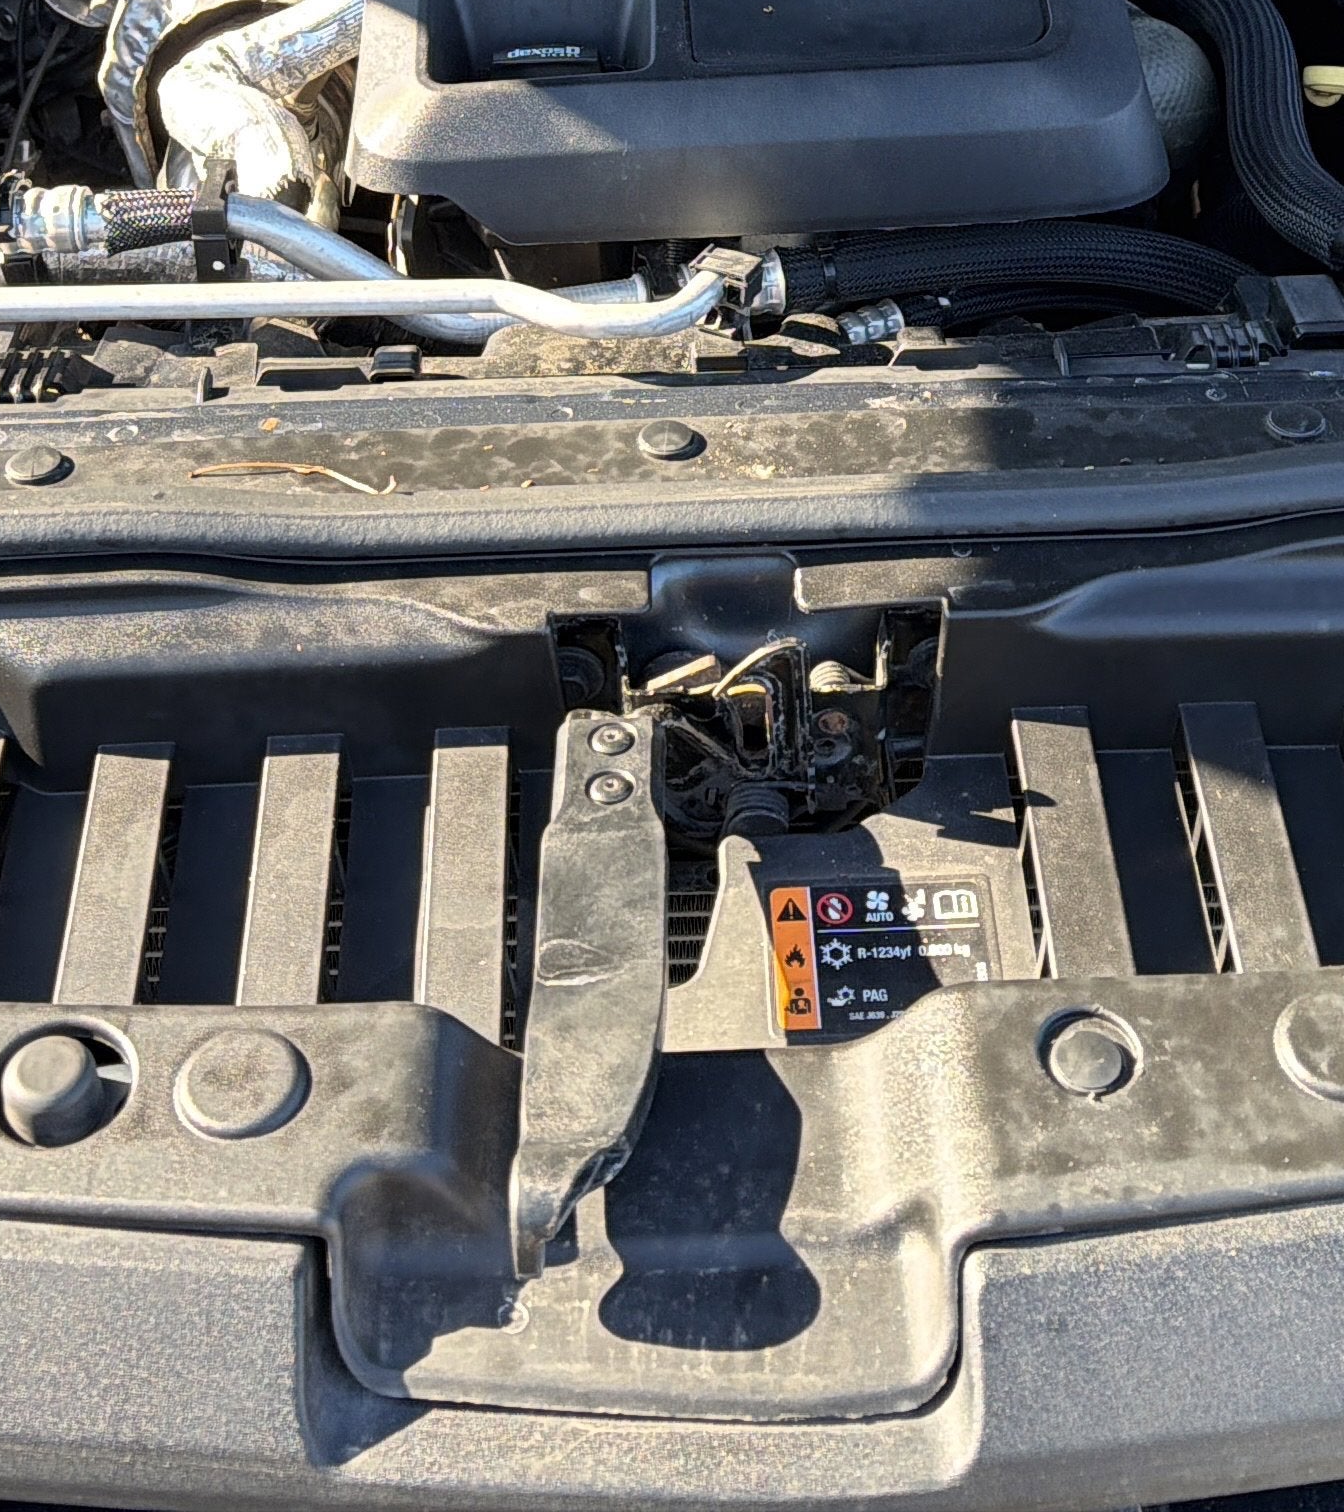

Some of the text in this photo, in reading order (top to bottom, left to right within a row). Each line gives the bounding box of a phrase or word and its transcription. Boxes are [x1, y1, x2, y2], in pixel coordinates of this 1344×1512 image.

[865, 912, 894, 923] AUTO
[857, 945, 912, 960] R-1234yf
[862, 989, 889, 1003] PAG
